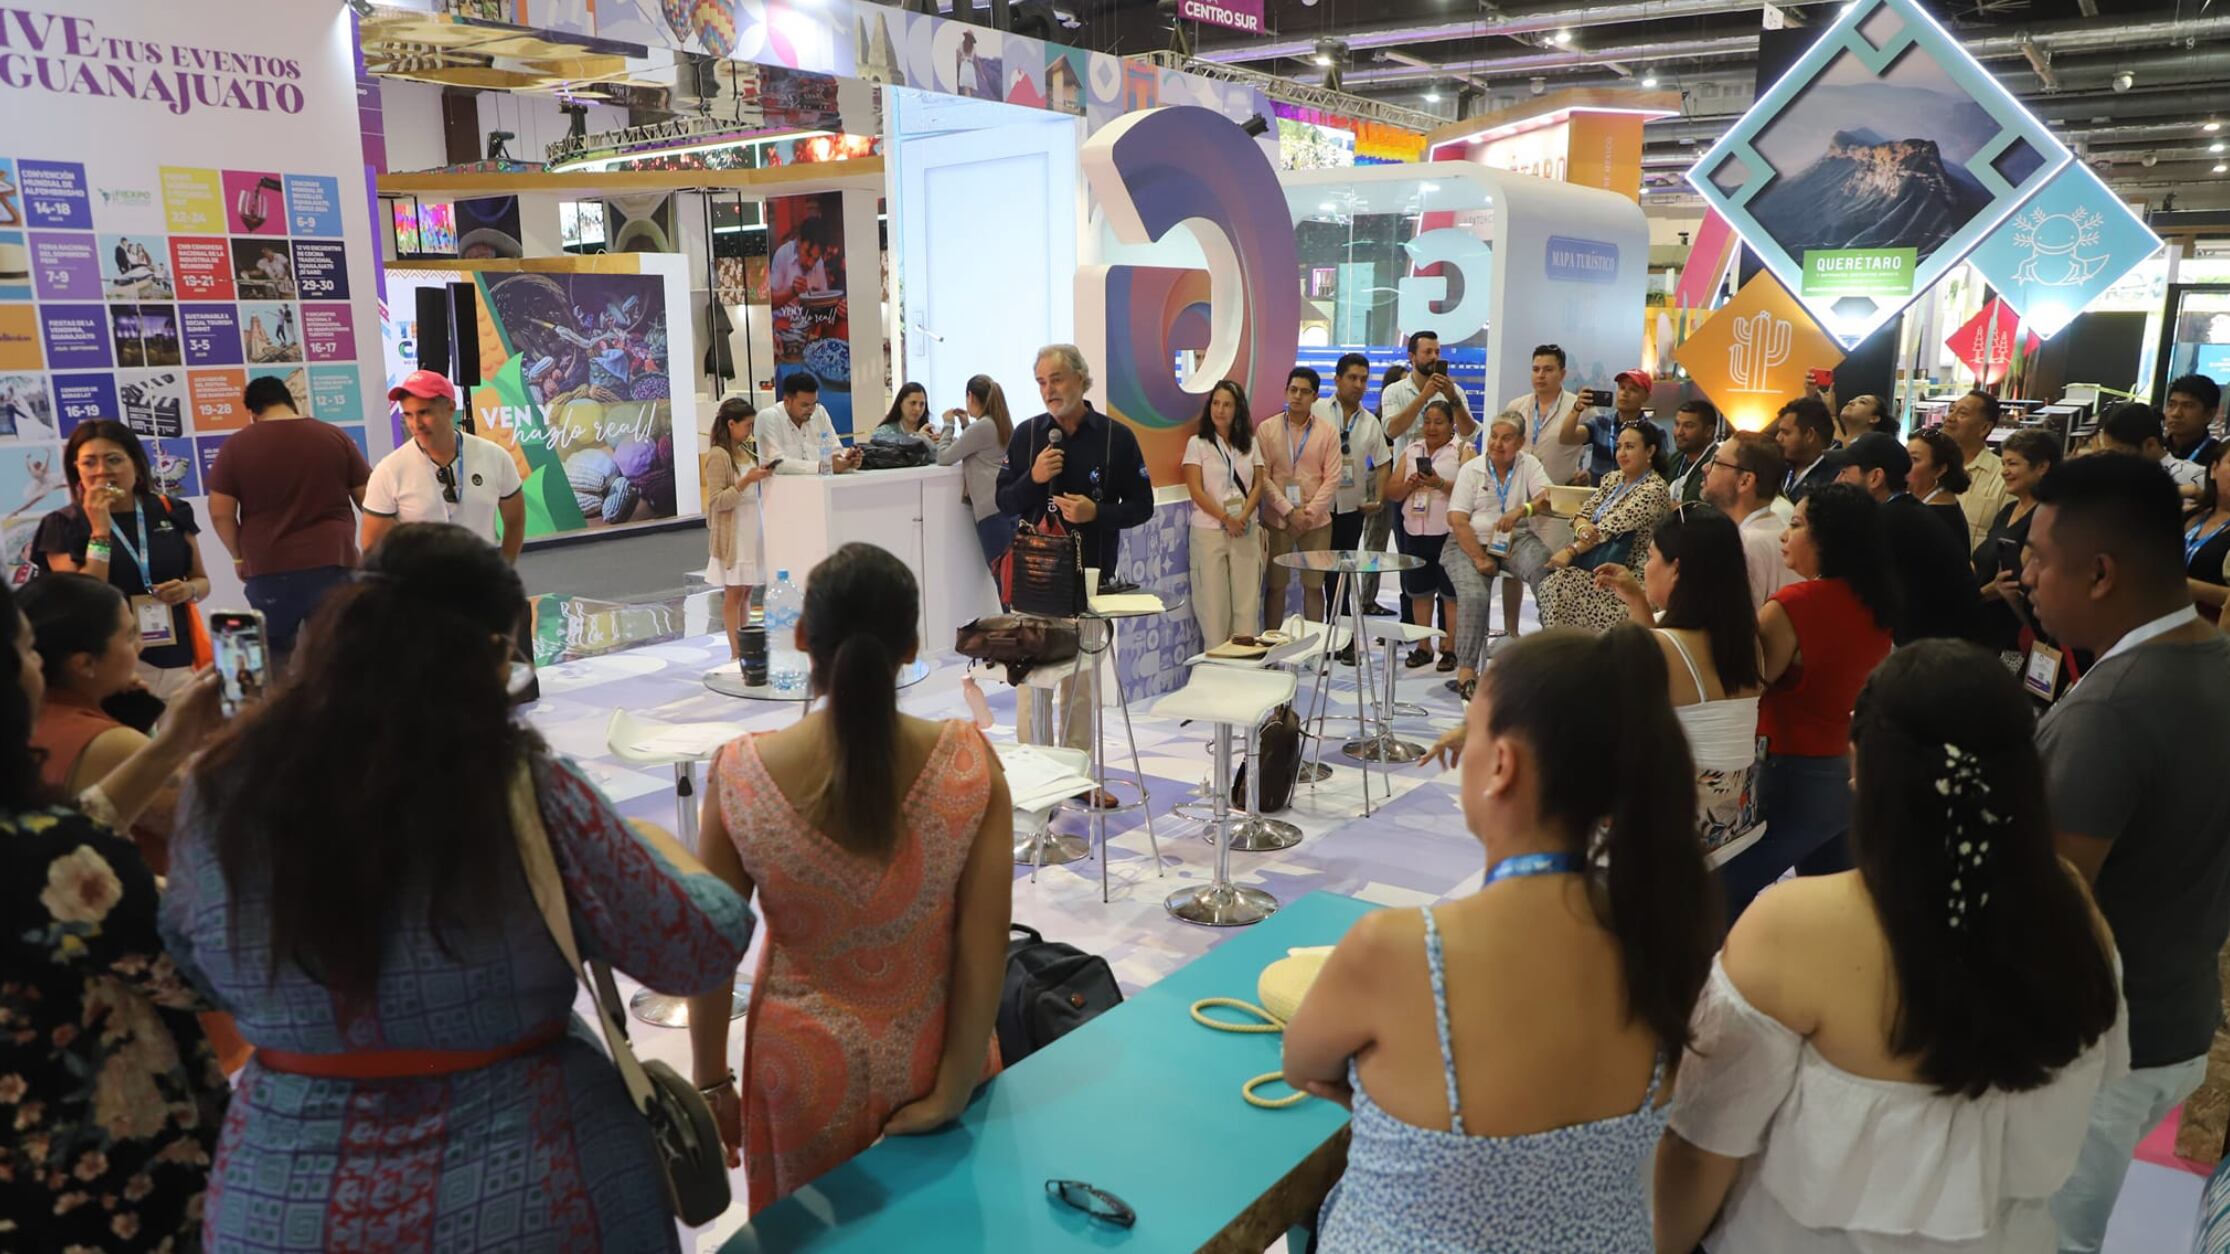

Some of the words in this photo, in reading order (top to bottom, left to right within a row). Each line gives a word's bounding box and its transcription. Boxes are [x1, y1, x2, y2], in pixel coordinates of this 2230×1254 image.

[1184, 1, 1233, 25] CENTRO
[1233, 12, 1257, 30] SUR
[102, 36, 163, 64] TUS
[171, 45, 301, 80] EVENTOS
[0, 53, 304, 115] GUANAJUATO
[34, 201, 72, 215] 14-18
[296, 216, 316, 228] 6-9
[1552, 249, 1575, 268] MAPA
[1576, 249, 1616, 273] TURÍSTICO
[1816, 253, 1902, 272] QUERÉTARO
[46, 270, 69, 283] 7-9
[182, 275, 215, 288] 19-21
[302, 280, 334, 290] 29-30
[189, 339, 211, 351] 3-5
[310, 342, 337, 353] 16-17
[64, 404, 100, 418] 16-19
[199, 403, 233, 415] 19-28
[480, 404, 533, 430] VEN
[538, 404, 555, 425] Y
[509, 407, 586, 450] hazlo
[593, 402, 657, 444] real!
